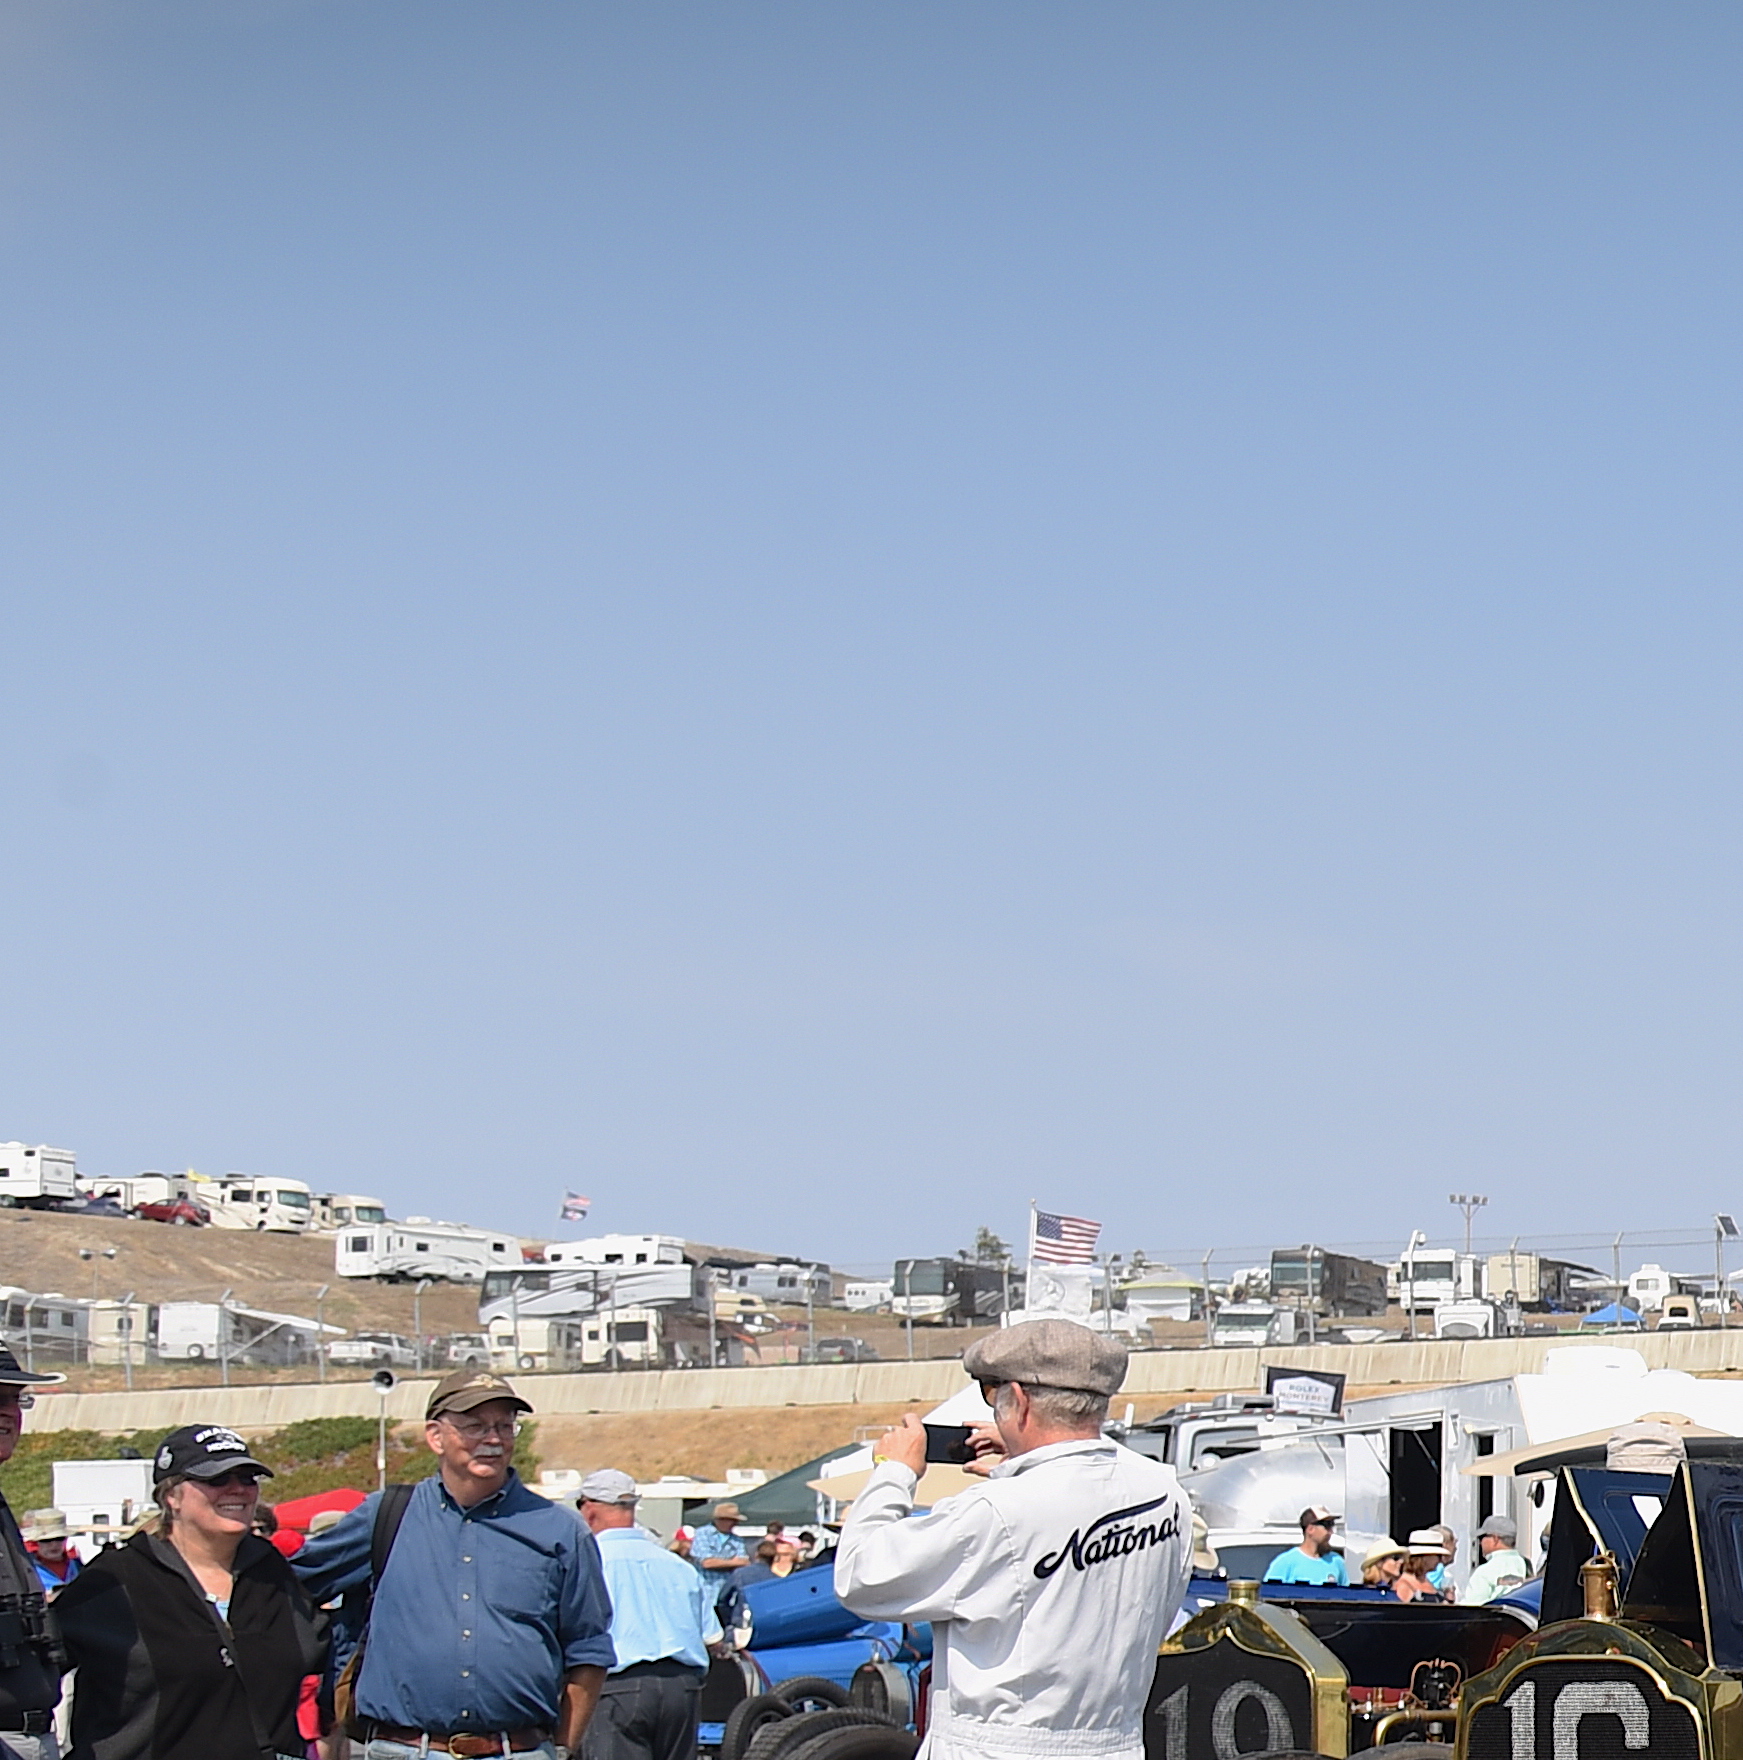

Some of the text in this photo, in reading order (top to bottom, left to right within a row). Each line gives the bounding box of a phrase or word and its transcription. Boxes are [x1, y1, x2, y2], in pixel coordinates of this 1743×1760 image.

[1288, 1384, 1321, 1394] ROLEX
[1278, 1391, 1330, 1403] MONTEREY
[1033, 1493, 1181, 1579] National
